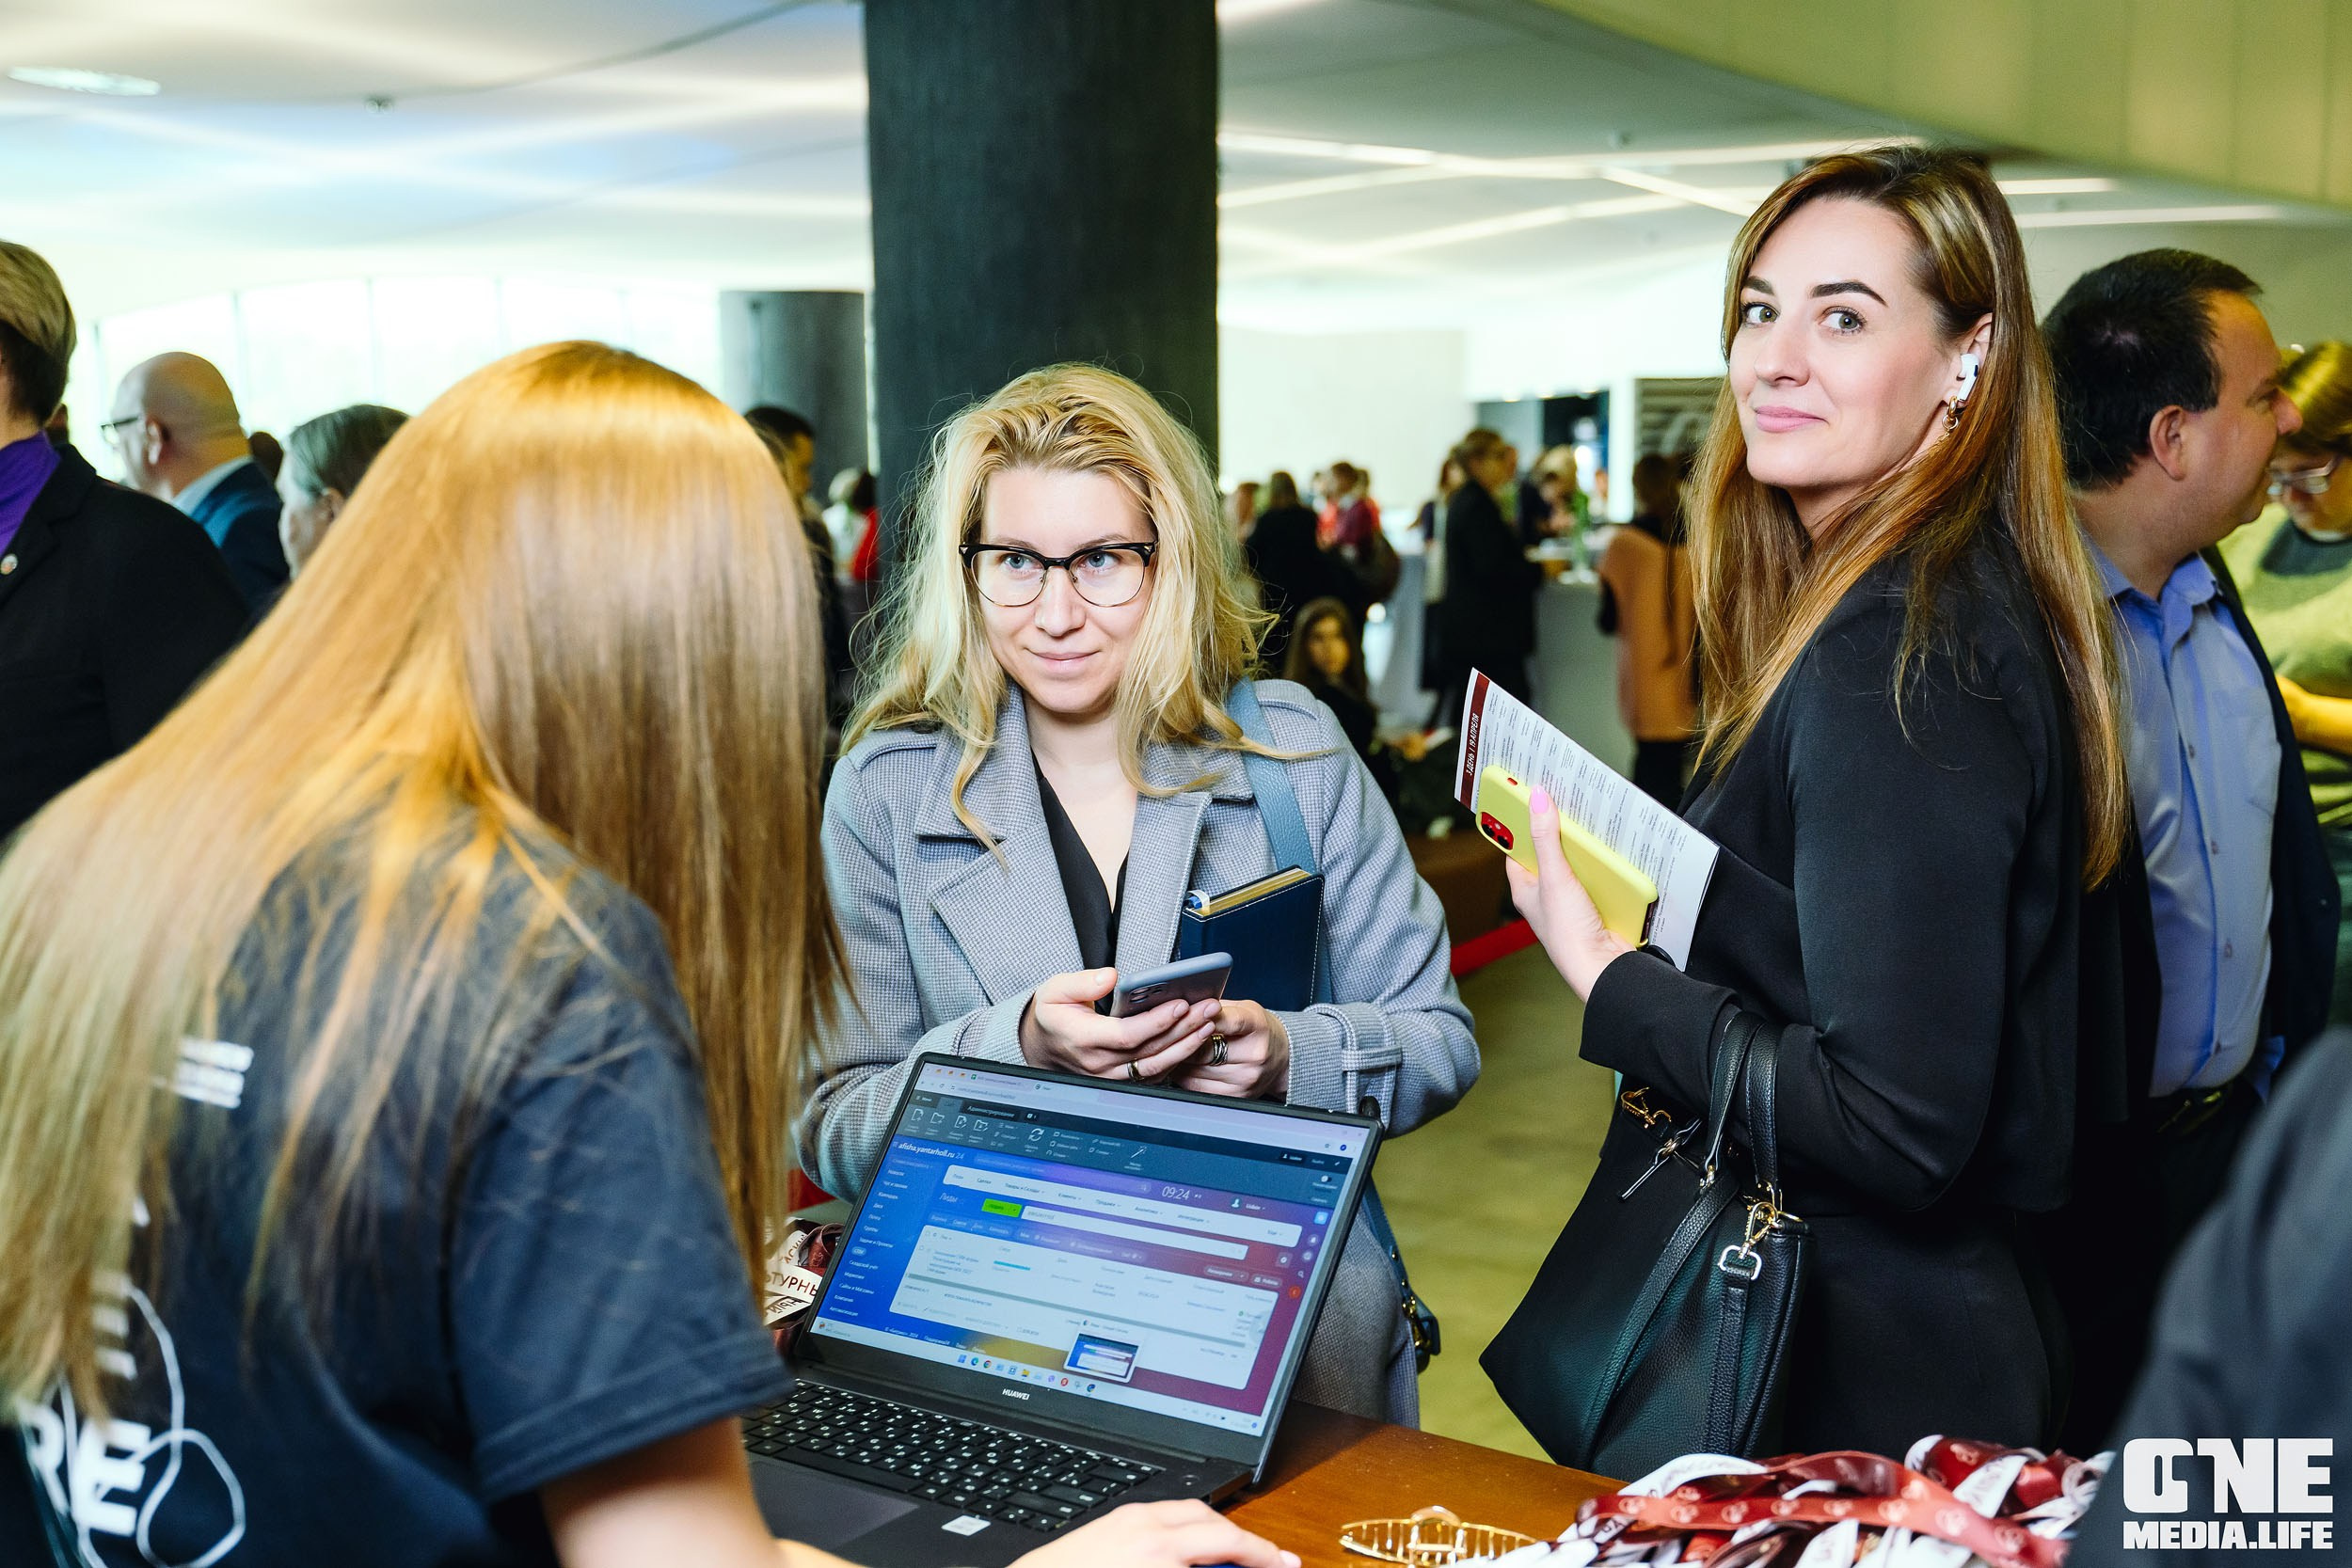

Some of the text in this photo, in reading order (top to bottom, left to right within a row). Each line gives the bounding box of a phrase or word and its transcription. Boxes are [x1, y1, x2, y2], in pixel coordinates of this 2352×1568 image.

[1470, 713, 1480, 739] АПРЕЛЯ
[1467, 753, 1475, 772] ДЕНЬ
[898, 1142, 955, 1159] afisha.yantarholl.ru
[1161, 1186, 1190, 1200] 09:24
[1002, 1388, 1031, 1402] HUAWEI
